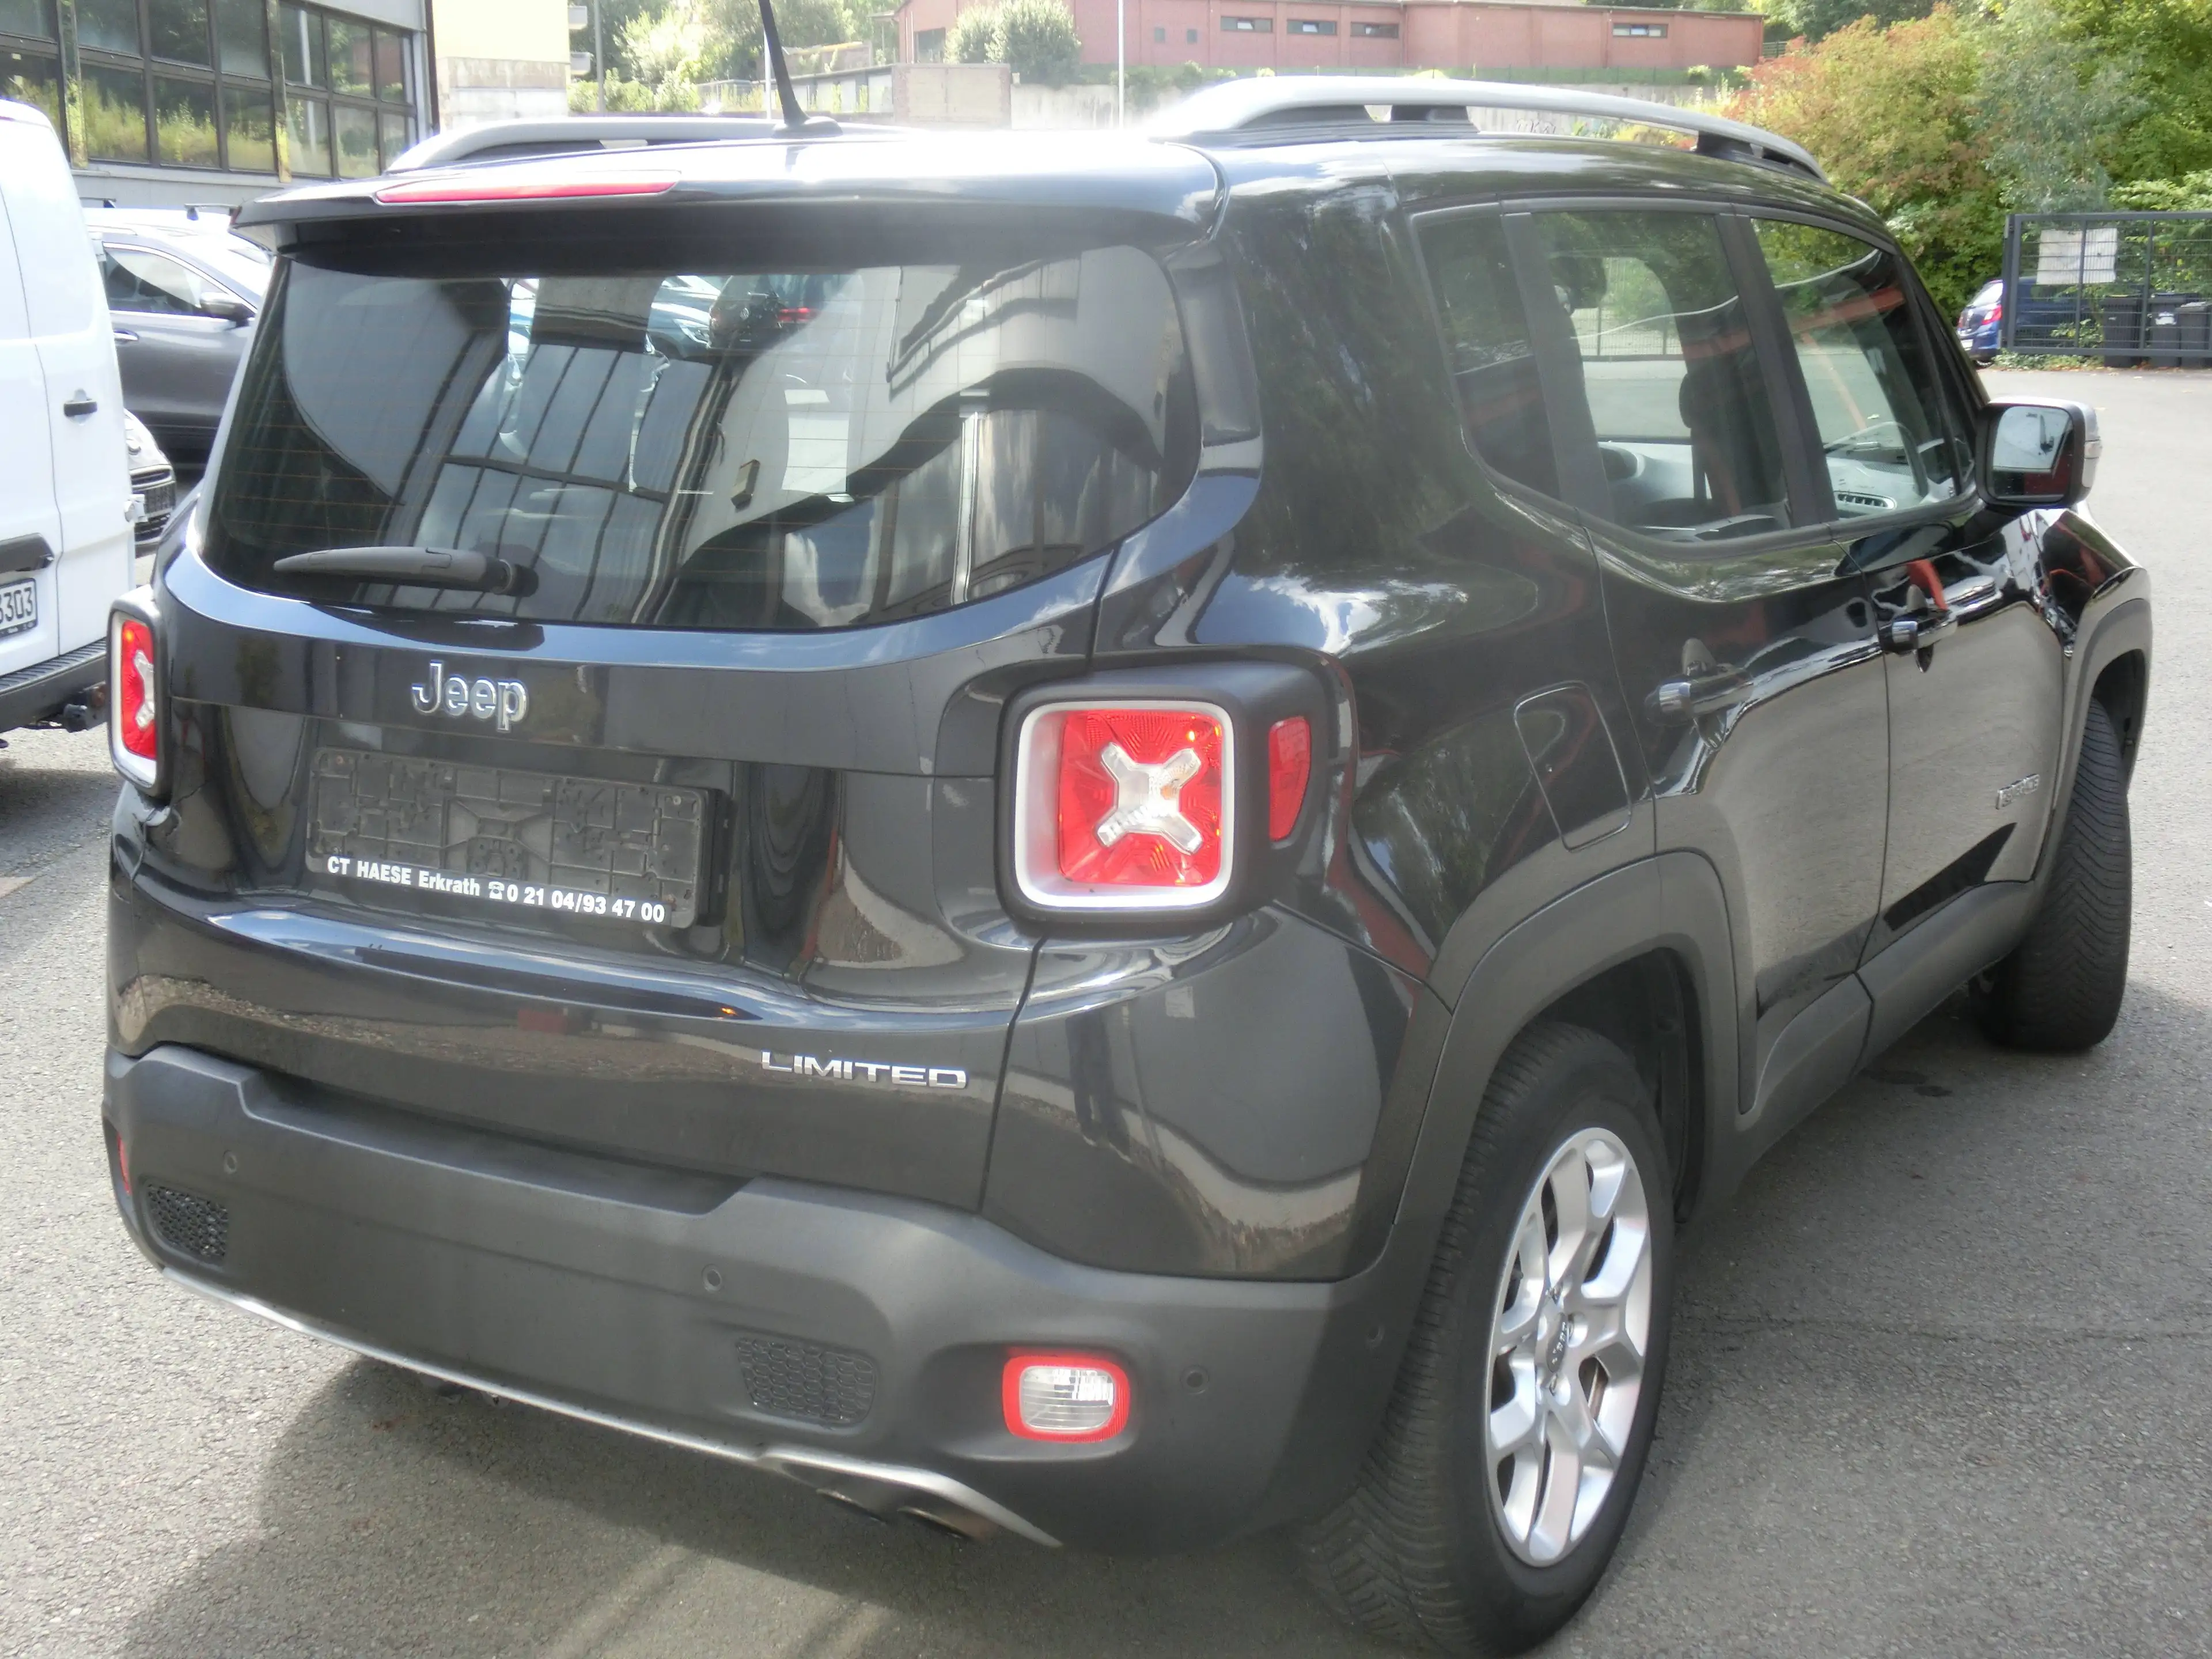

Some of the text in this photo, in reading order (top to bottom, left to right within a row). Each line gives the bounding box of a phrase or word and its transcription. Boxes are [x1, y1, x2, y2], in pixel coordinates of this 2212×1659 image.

[411, 660, 529, 732] Jeep
[327, 855, 350, 874] CT
[357, 860, 411, 885] HAESE
[419, 870, 480, 896] Erkrath
[524, 887, 544, 906] 21
[551, 890, 607, 915] 04/93
[612, 899, 636, 918] 47
[641, 902, 665, 923] 00
[761, 1050, 968, 1089] LIMITED
